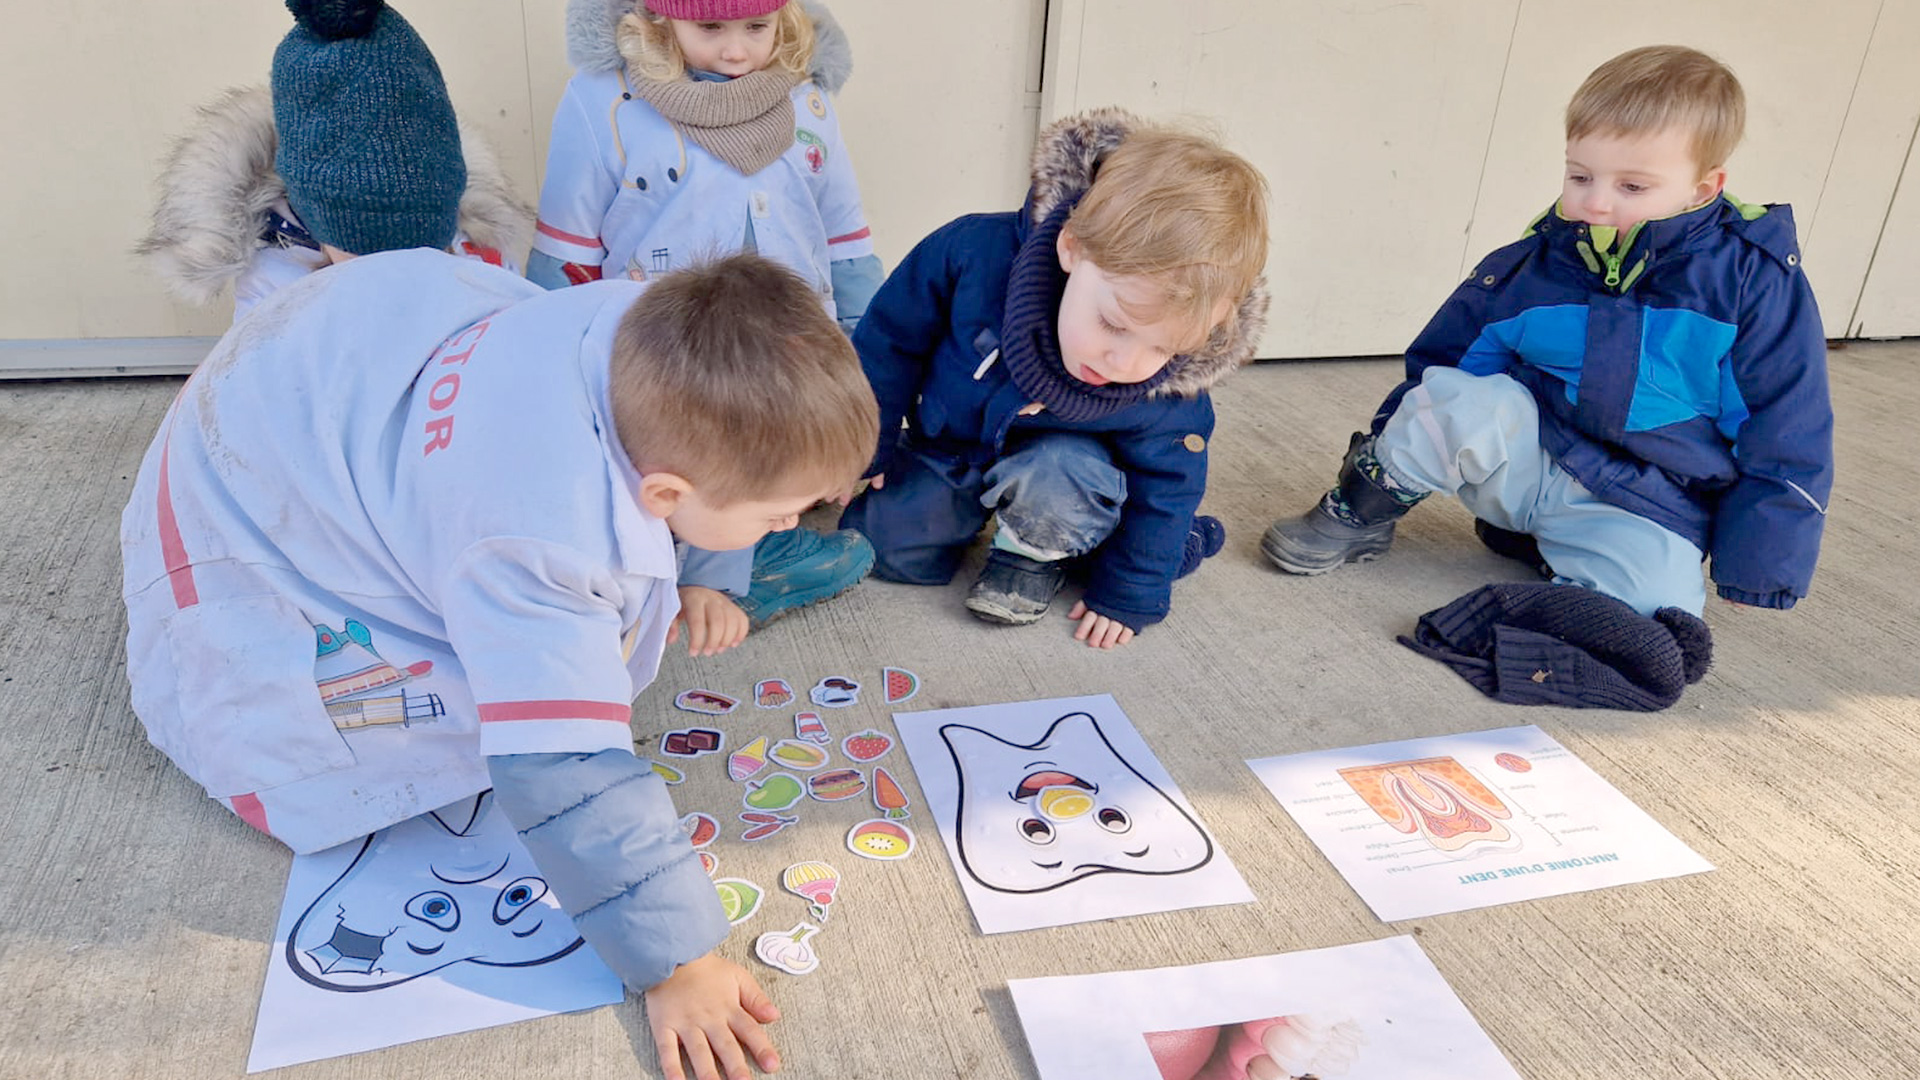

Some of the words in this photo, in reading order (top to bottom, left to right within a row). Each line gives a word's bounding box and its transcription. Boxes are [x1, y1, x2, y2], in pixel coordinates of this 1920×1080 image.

[424, 321, 490, 457] CTOR
[1546, 852, 1619, 871] ANATOMIE
[1458, 871, 1499, 885] DENT
[1498, 863, 1545, 878] D'UNE
